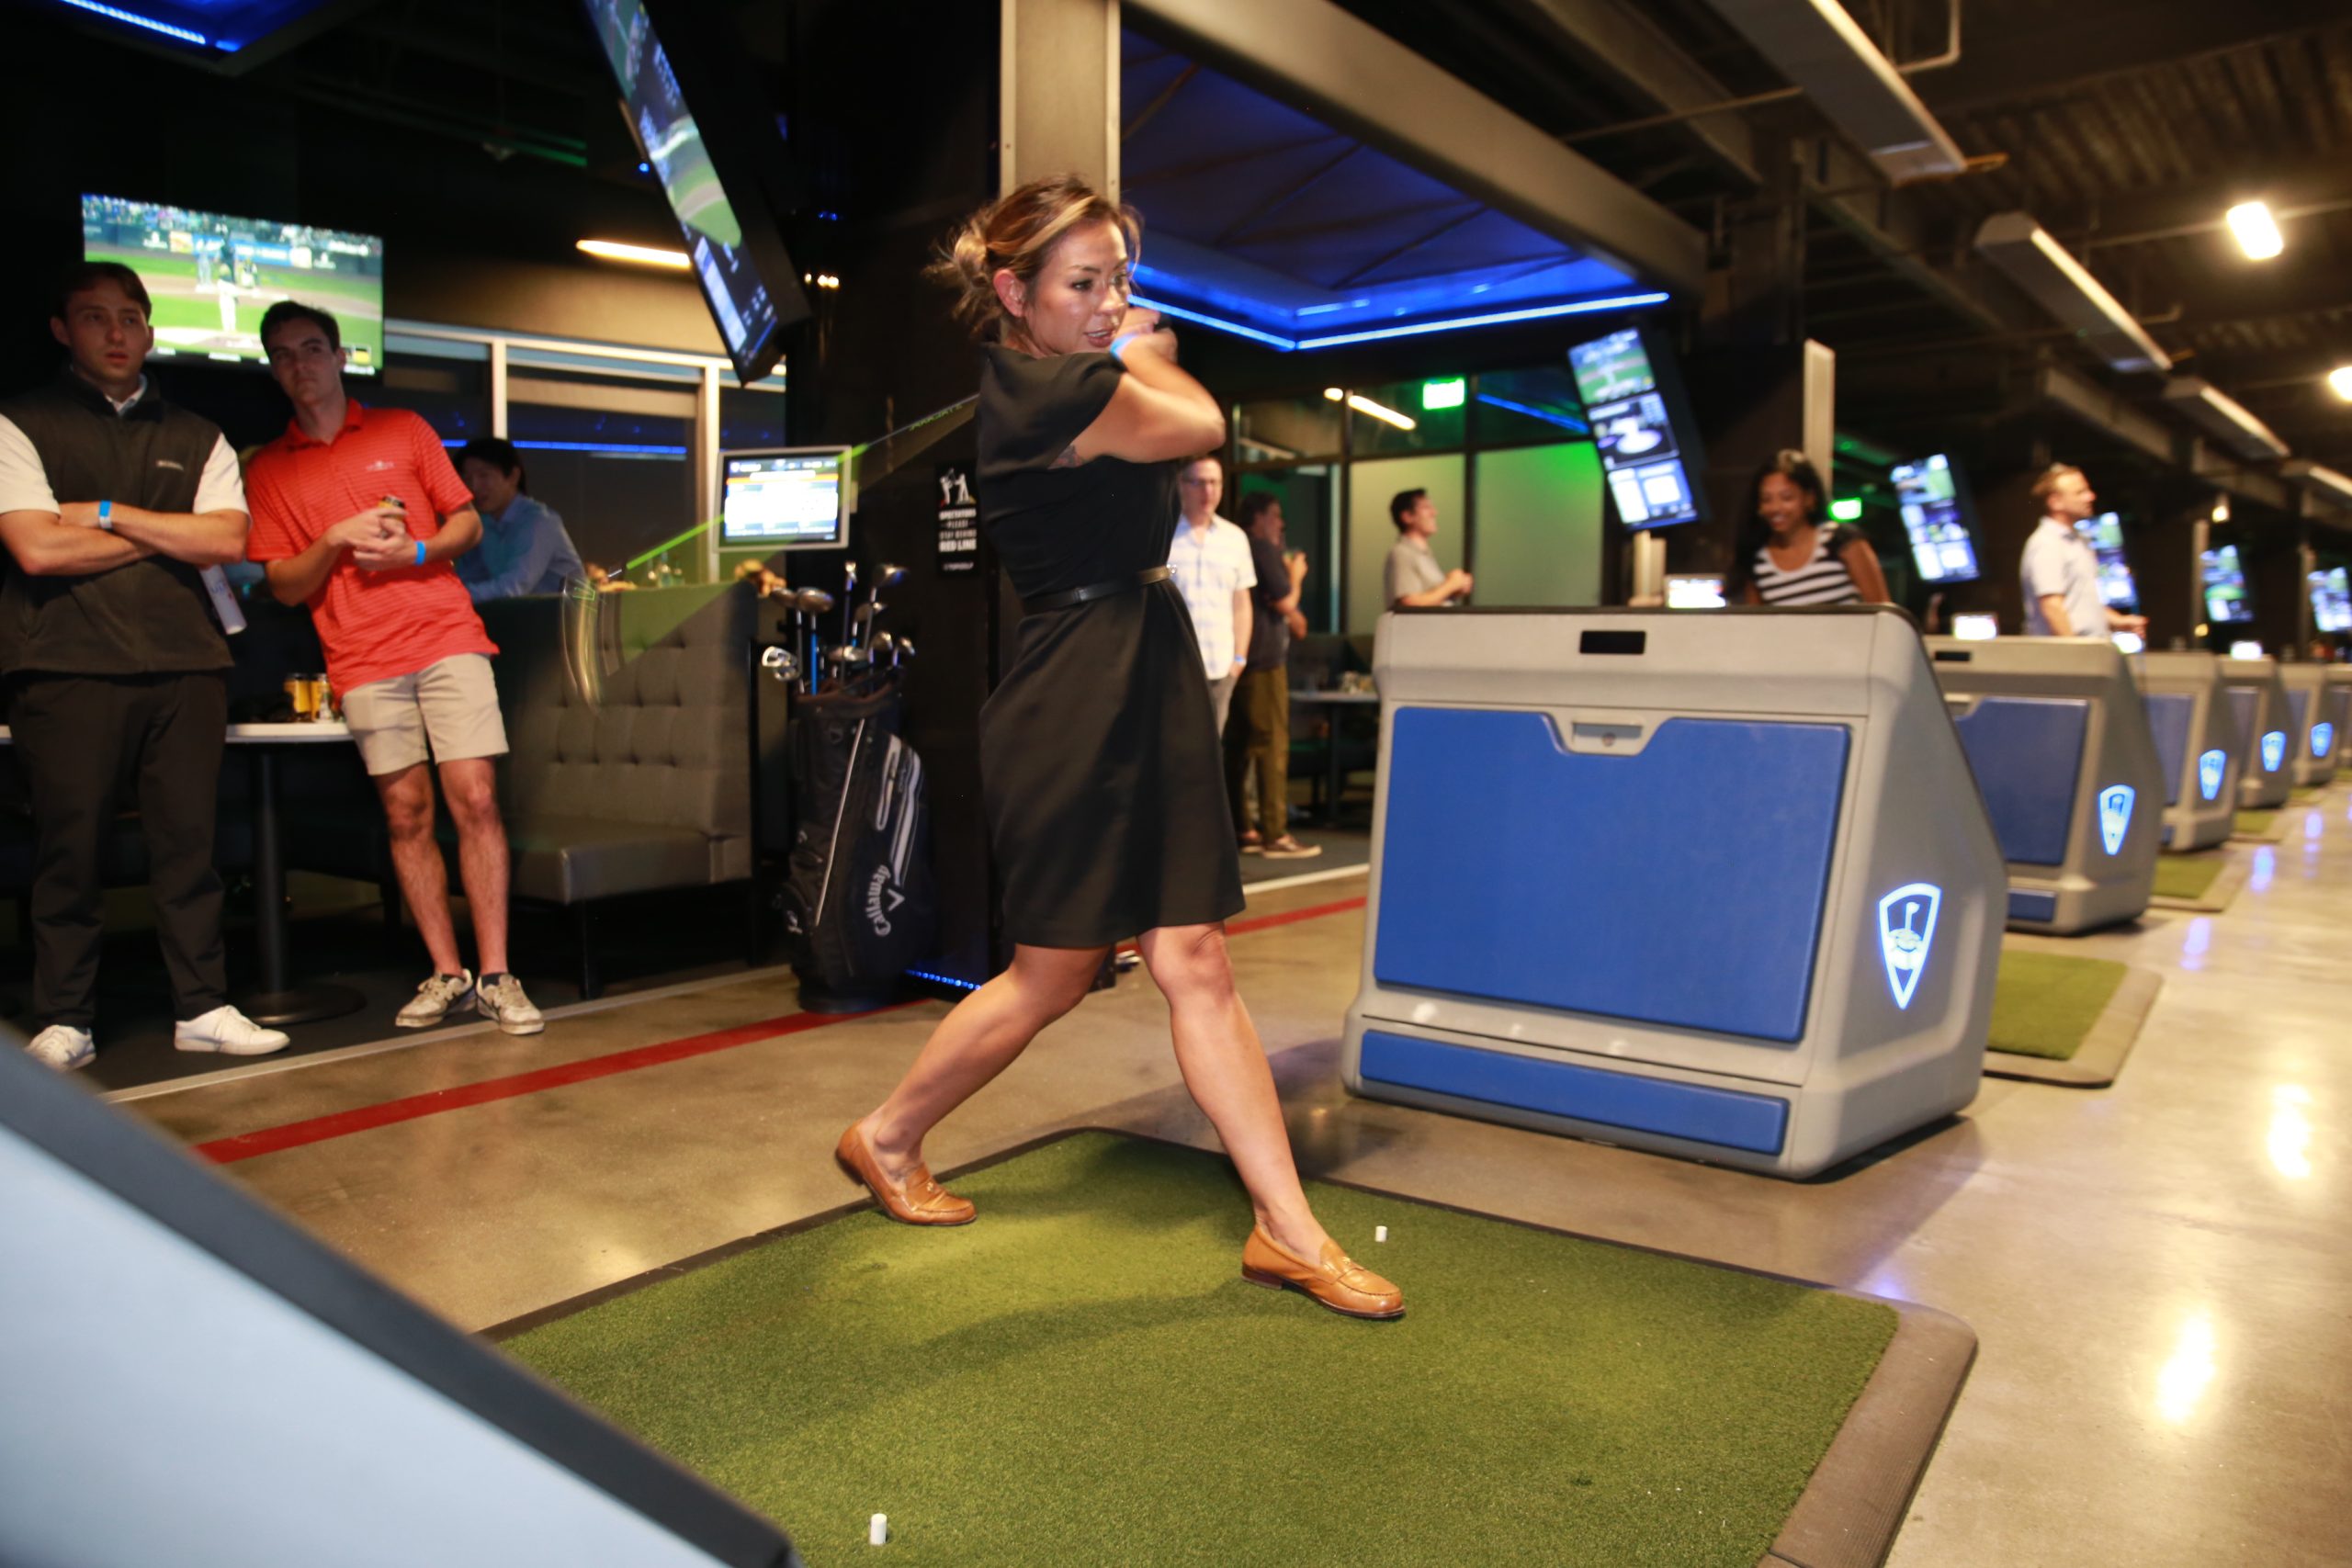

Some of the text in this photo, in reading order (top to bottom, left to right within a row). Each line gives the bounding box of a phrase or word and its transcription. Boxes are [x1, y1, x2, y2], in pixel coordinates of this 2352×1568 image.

[939, 538, 977, 552] RED LINE
[865, 864, 891, 936] Callaway
